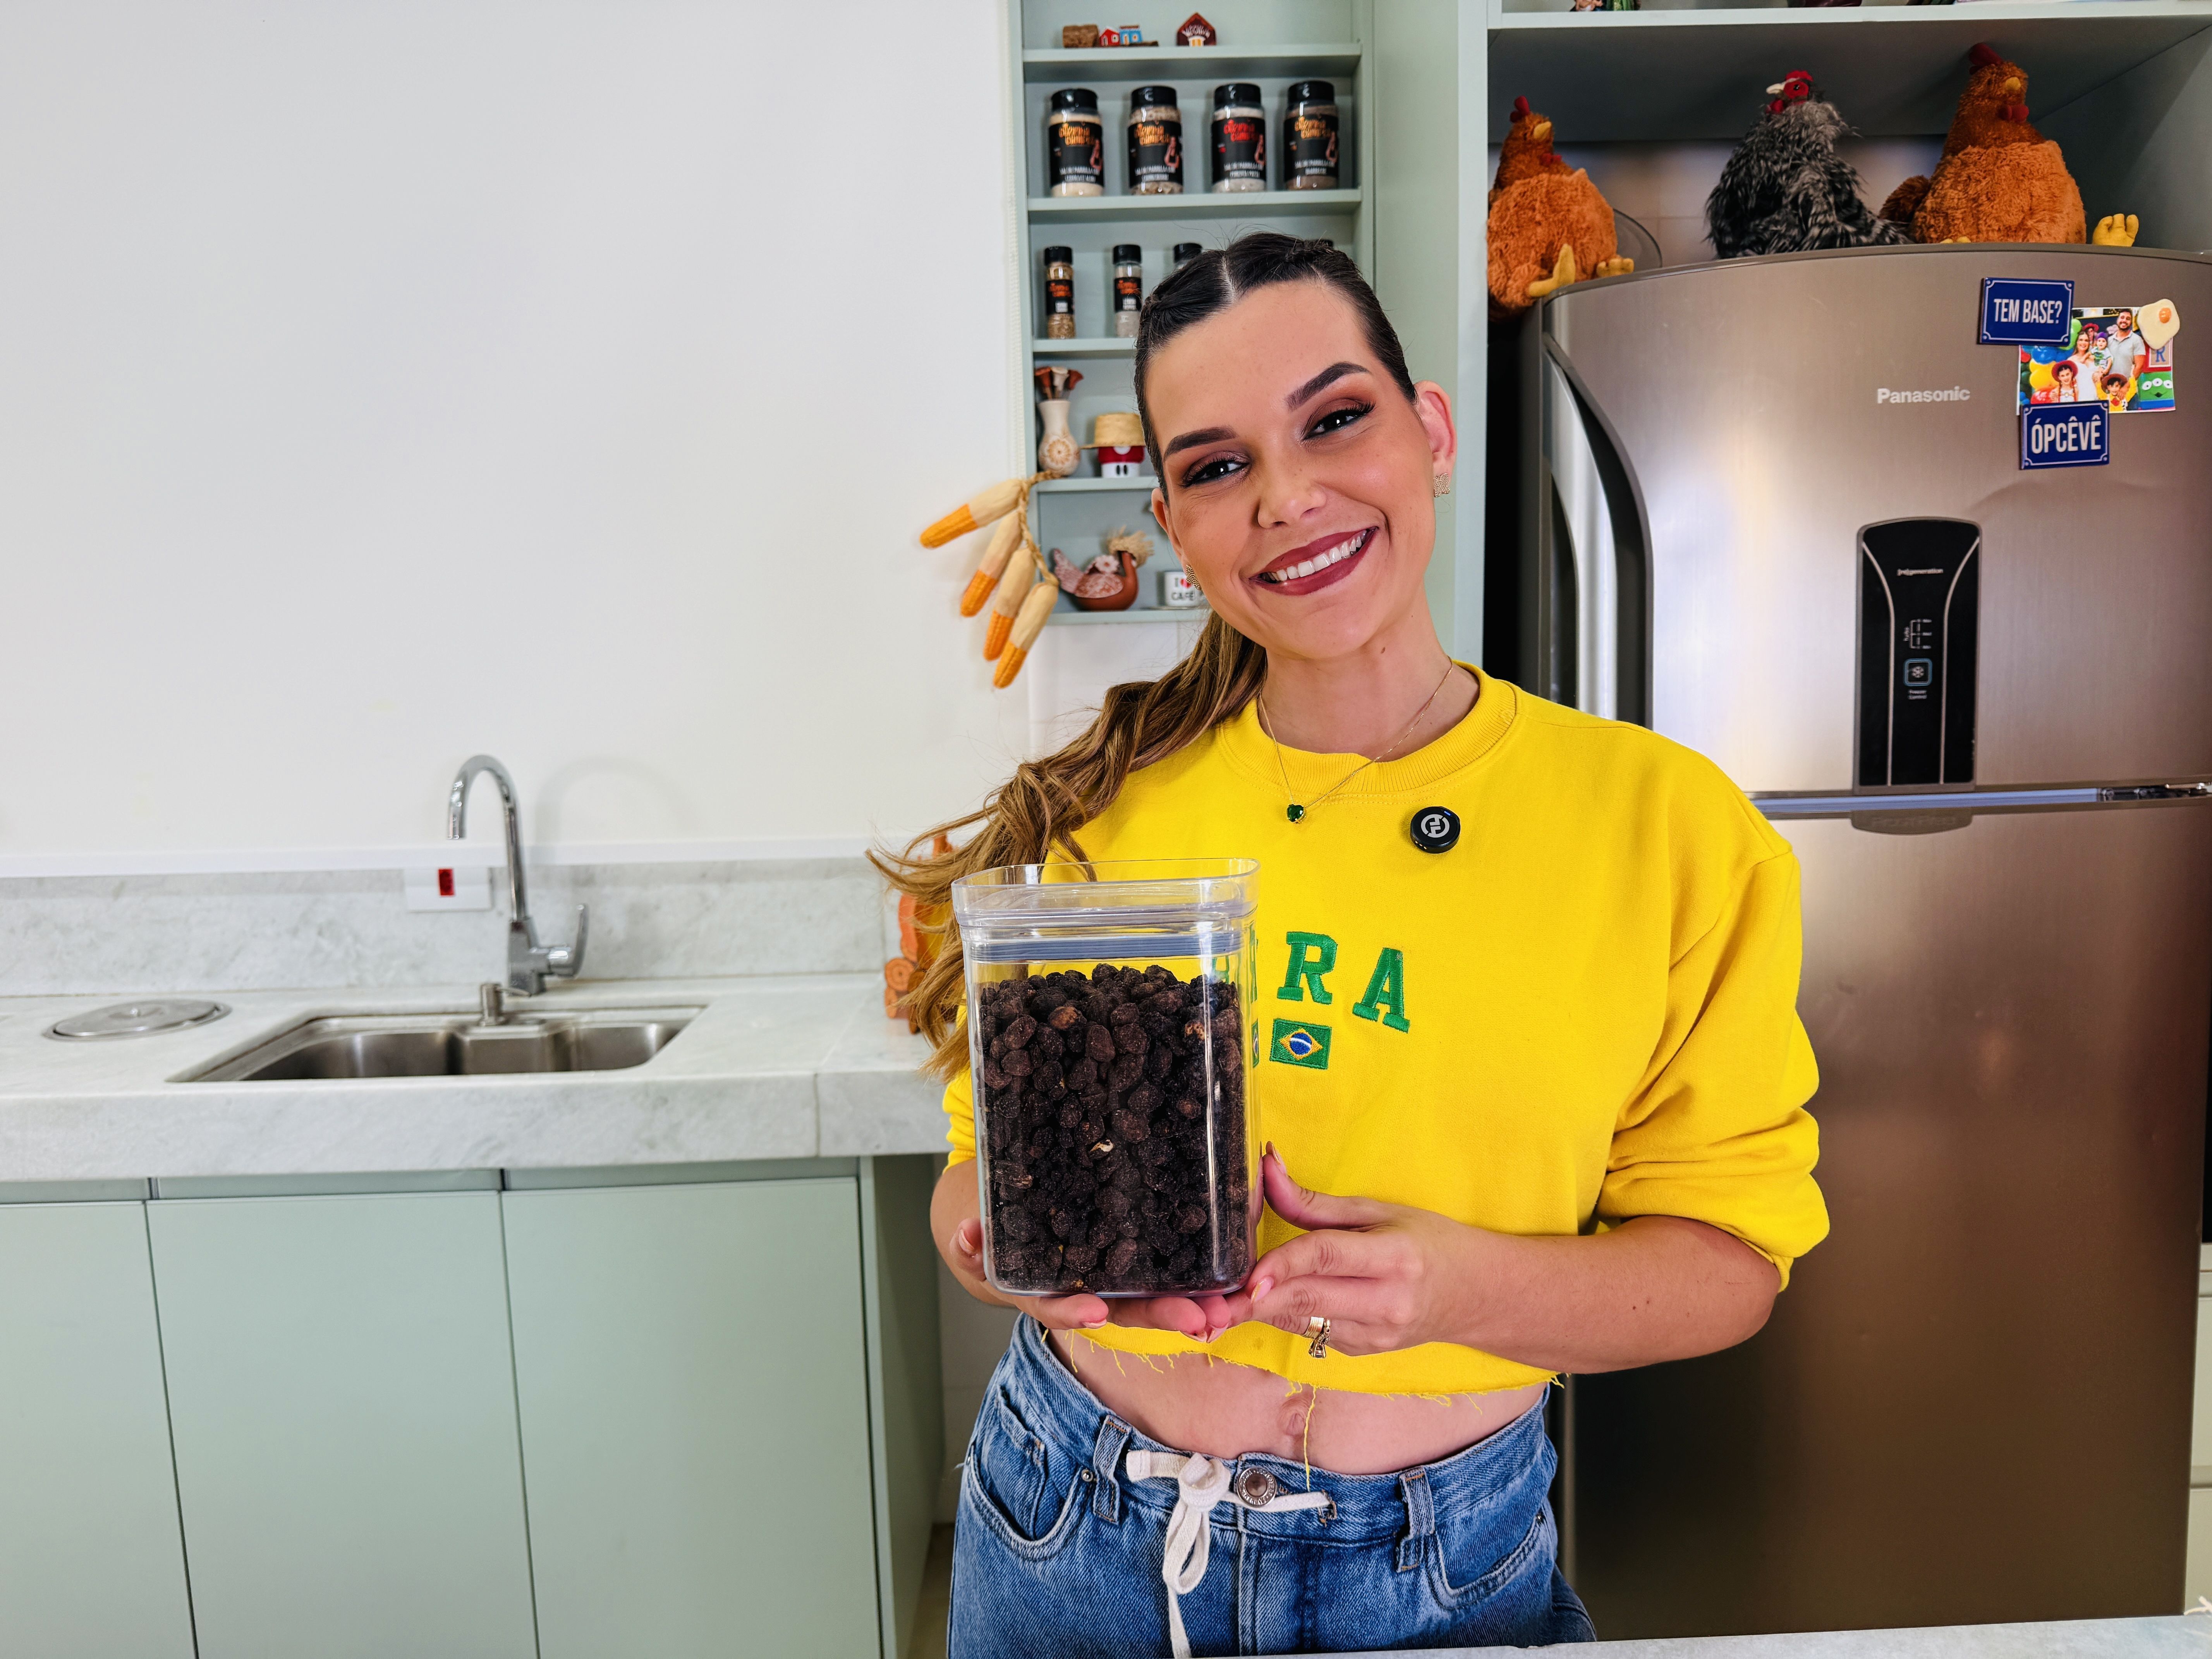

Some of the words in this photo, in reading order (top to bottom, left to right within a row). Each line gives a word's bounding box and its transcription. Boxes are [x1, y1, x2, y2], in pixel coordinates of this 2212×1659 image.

[1994, 299, 2020, 322] TEM
[2022, 299, 2063, 324] BASE?
[1877, 386, 1970, 404] Panasonic
[2032, 414, 2101, 454] ÓPCÊVÊ
[1277, 931, 1410, 1034] RA
